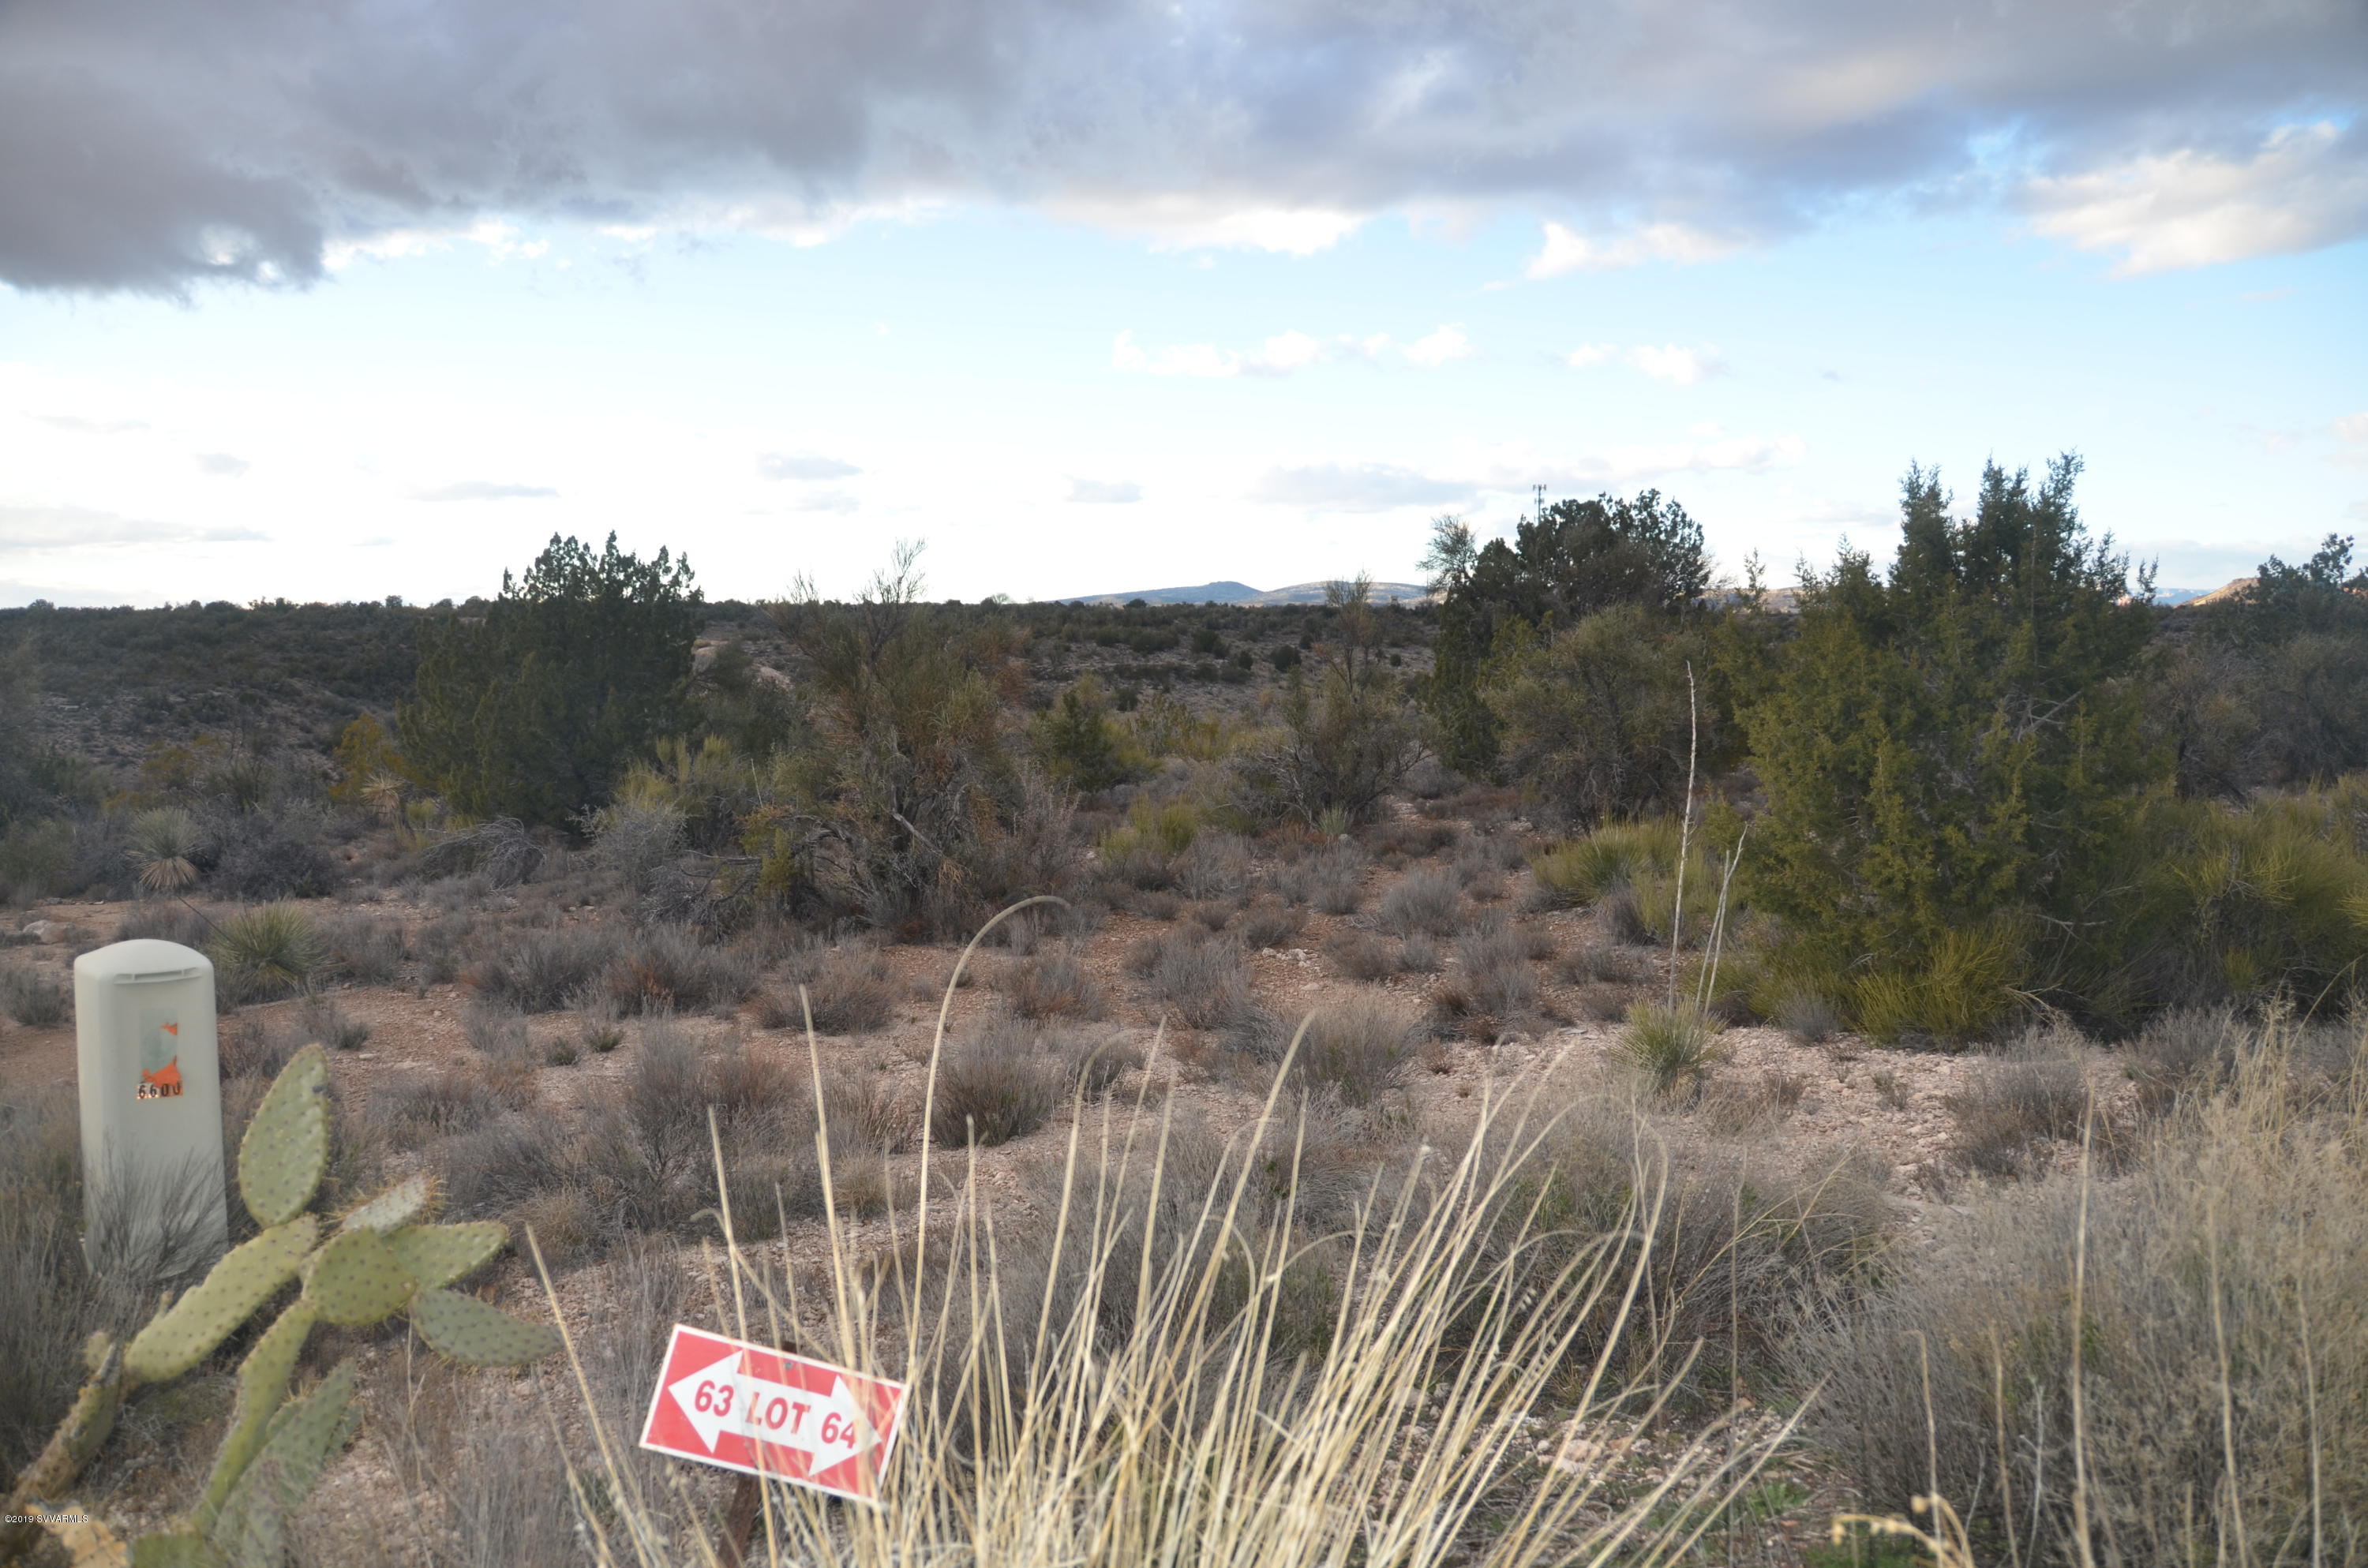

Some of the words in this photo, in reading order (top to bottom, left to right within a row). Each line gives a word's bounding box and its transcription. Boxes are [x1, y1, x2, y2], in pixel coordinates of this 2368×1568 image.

[695, 1380, 735, 1416] 63
[745, 1393, 811, 1434] LOT
[821, 1413, 857, 1449] 64
